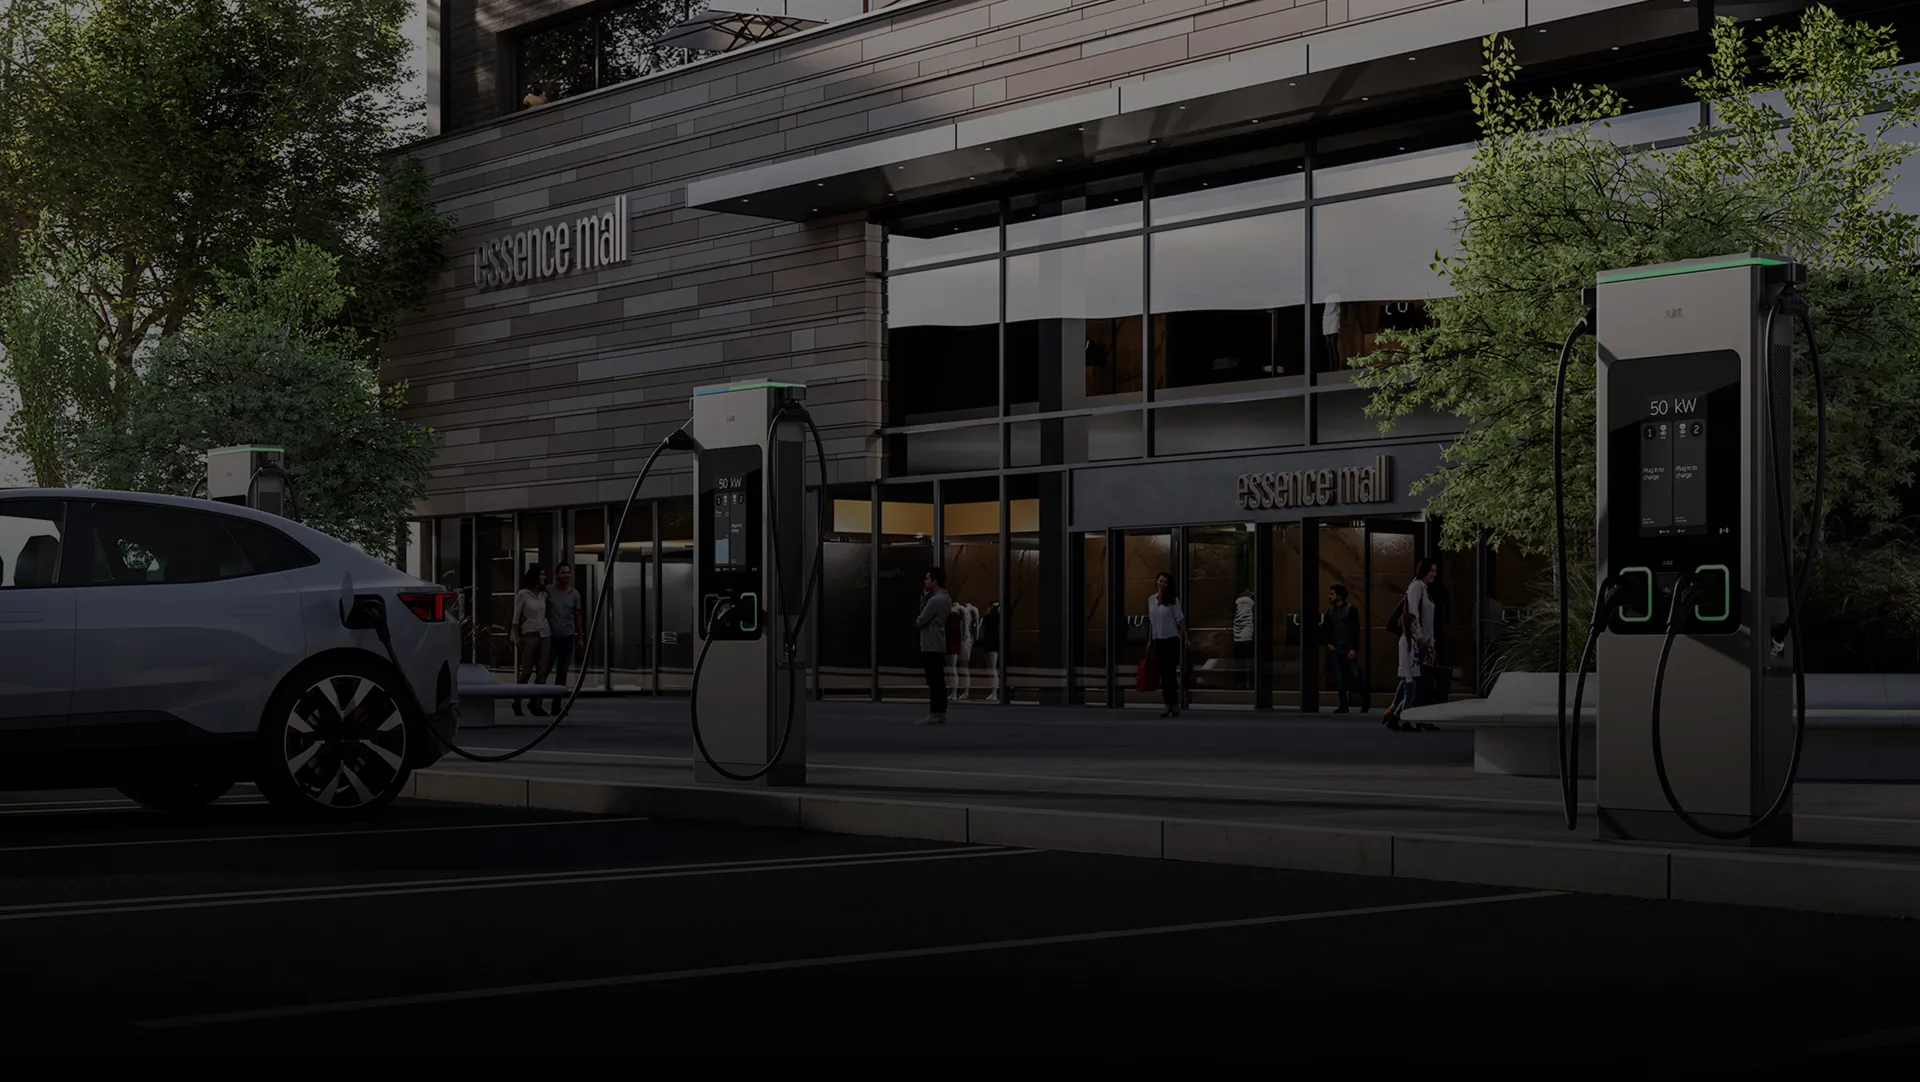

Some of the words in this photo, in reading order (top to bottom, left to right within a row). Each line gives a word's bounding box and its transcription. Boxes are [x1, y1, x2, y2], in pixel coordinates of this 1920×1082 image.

[473, 221, 571, 291] essence
[576, 193, 631, 270] mall
[1650, 399, 1669, 416] 50
[1674, 397, 1698, 414] kW
[718, 477, 729, 490] 50
[730, 476, 743, 489] kW
[1236, 467, 1335, 510] essence
[1337, 454, 1391, 504] mall
